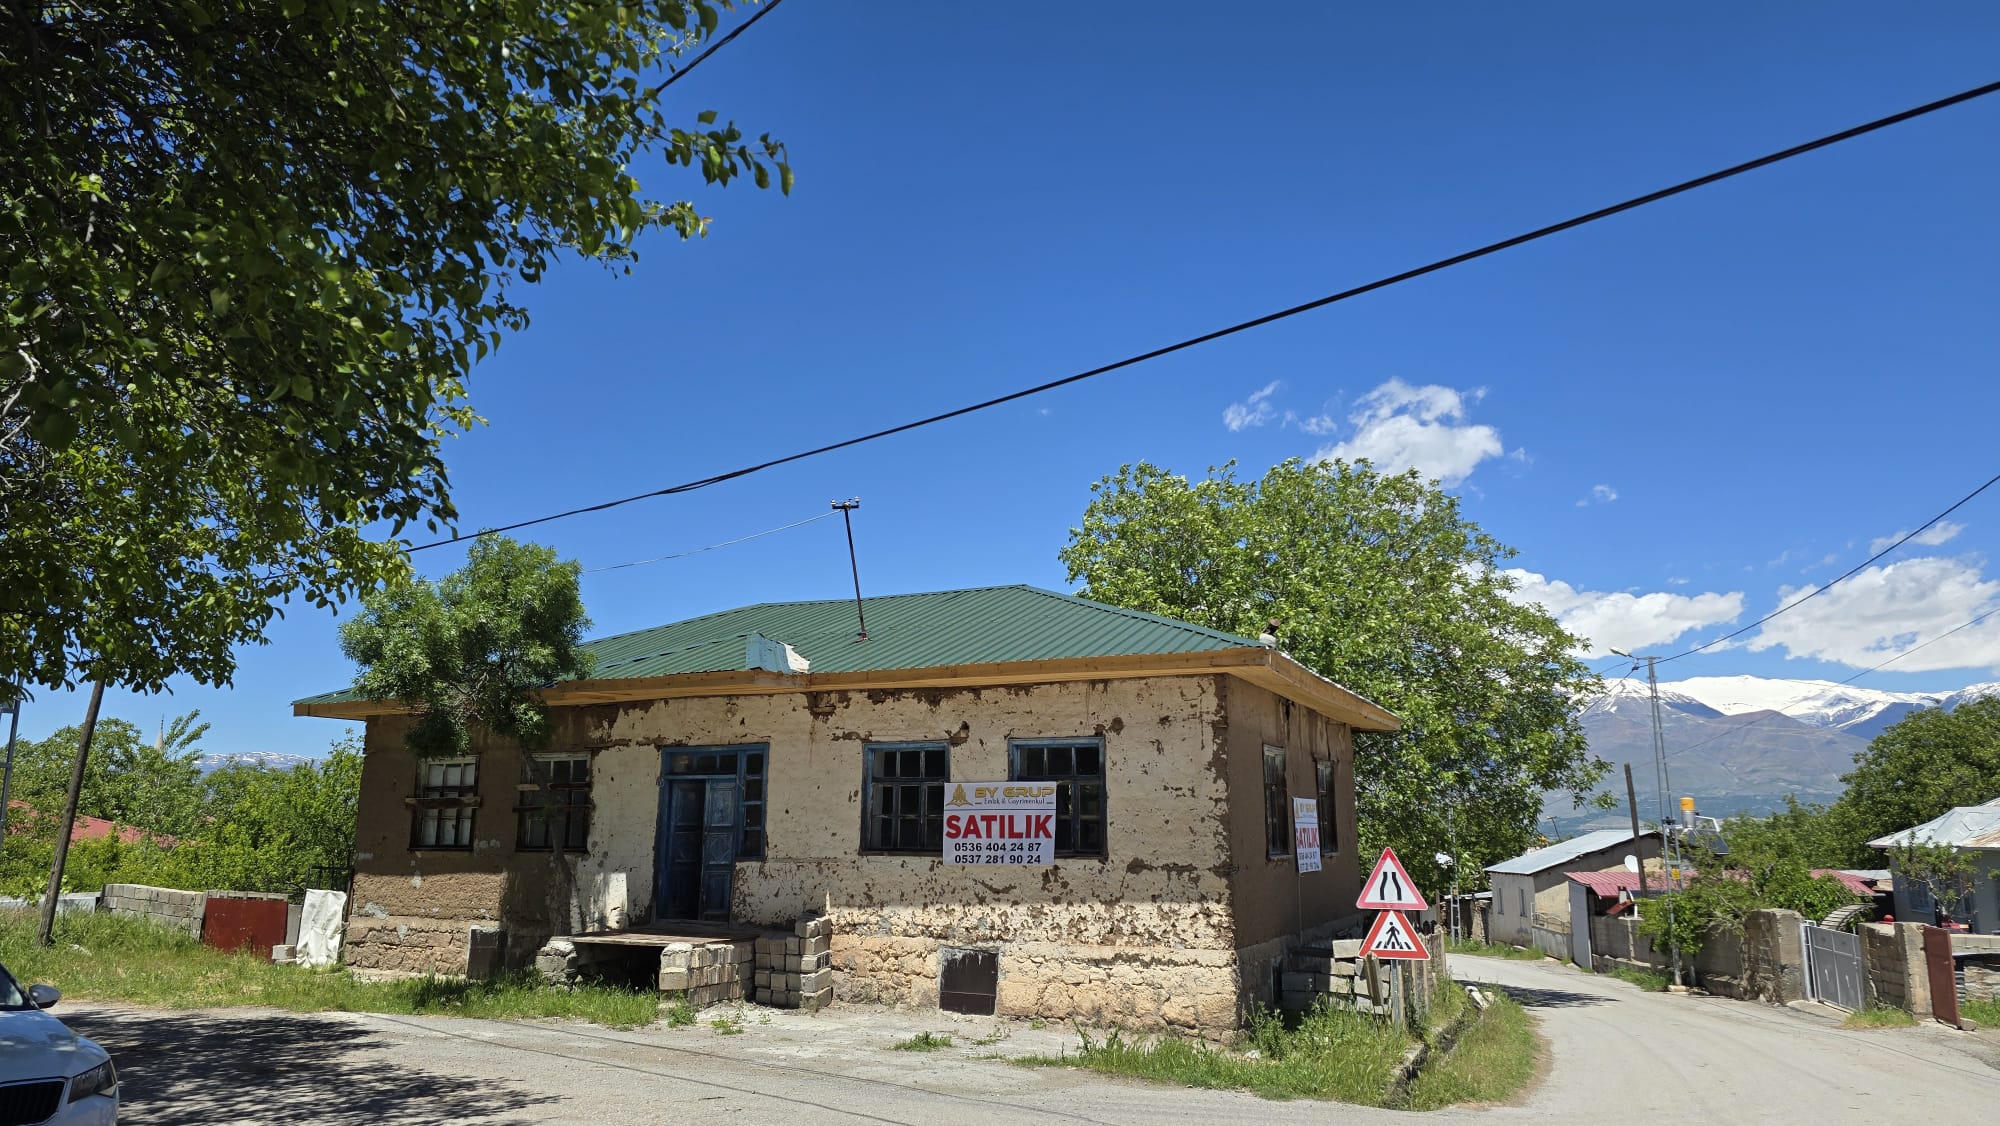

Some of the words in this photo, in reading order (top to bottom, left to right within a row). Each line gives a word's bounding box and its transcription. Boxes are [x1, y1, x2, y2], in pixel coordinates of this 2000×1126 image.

[975, 786, 999, 798] BY
[1003, 786, 1055, 798] GRUP
[946, 815, 1053, 839] SATILIK
[954, 842, 982, 852] 0536
[986, 842, 1006, 852] 404
[1010, 842, 1024, 851] 24
[1028, 842, 1042, 851] 87
[954, 855, 982, 864] 0537
[985, 855, 1004, 864] 281
[1009, 855, 1023, 864] 90
[1027, 855, 1041, 863] 24
